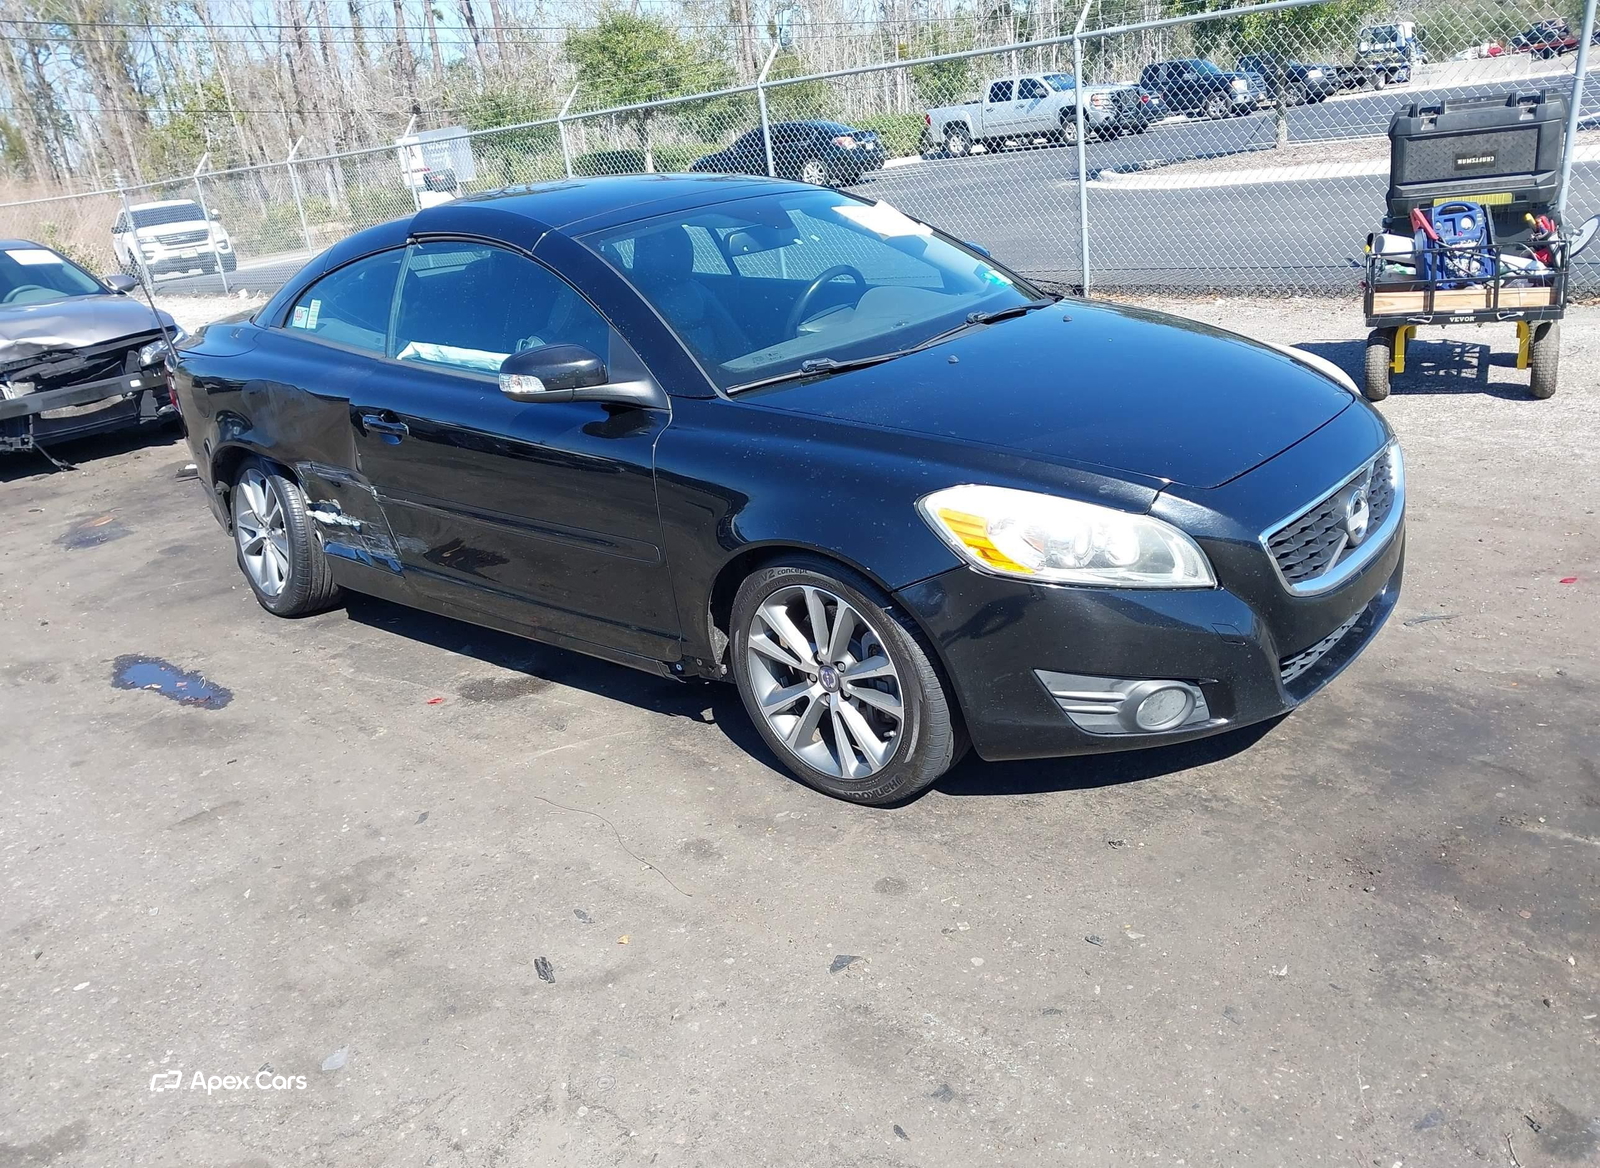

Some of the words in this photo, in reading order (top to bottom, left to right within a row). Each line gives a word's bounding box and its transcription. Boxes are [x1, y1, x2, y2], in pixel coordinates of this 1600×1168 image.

[1457, 155, 1495, 165] CRAFTSMAN
[761, 568, 775, 581] V2
[777, 567, 808, 575] concept
